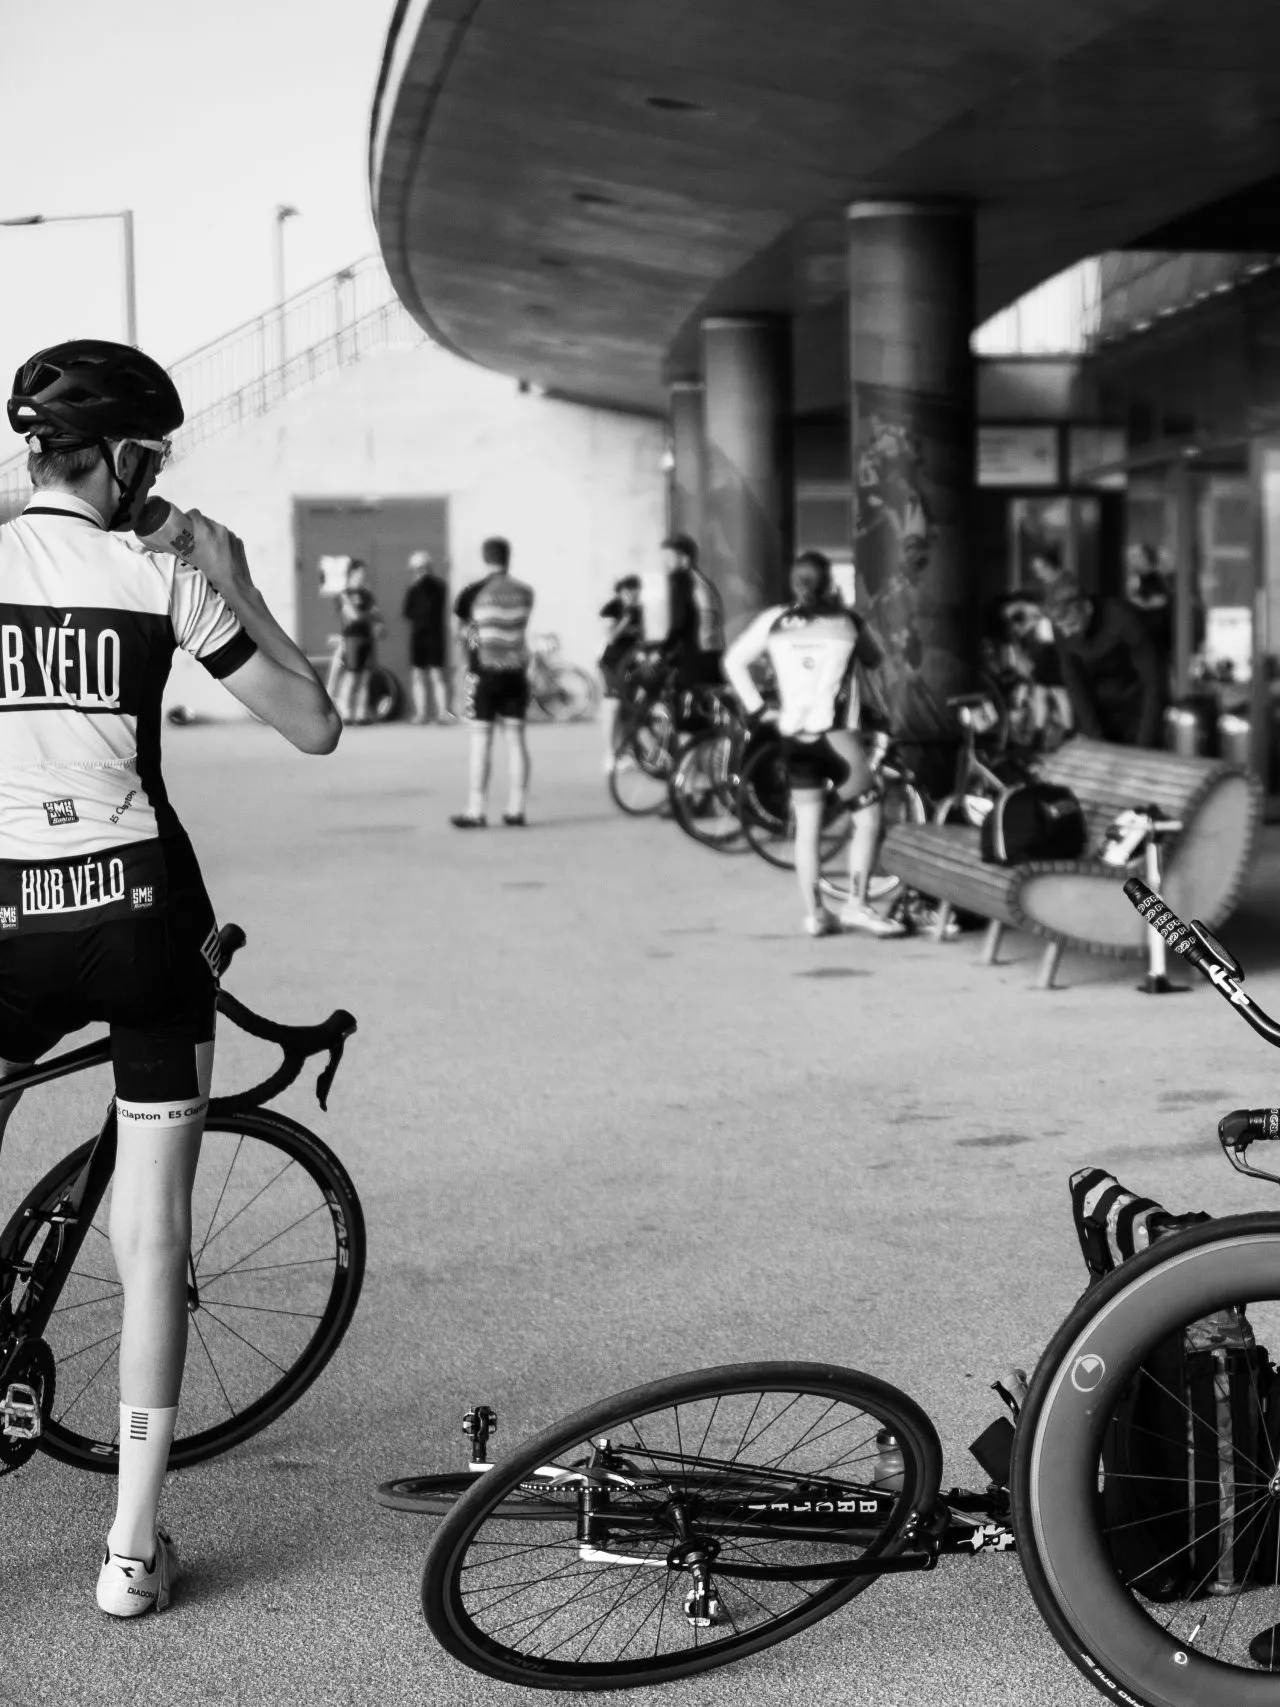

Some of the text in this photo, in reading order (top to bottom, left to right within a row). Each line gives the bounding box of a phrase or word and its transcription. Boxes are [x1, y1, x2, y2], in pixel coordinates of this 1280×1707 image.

[34, 612, 121, 704] VÉLO
[21, 856, 125, 912] HUB VÉLO
[121, 1107, 162, 1121] Clapton
[167, 1110, 183, 1120] E5
[126, 1586, 157, 1599] DIADOR
